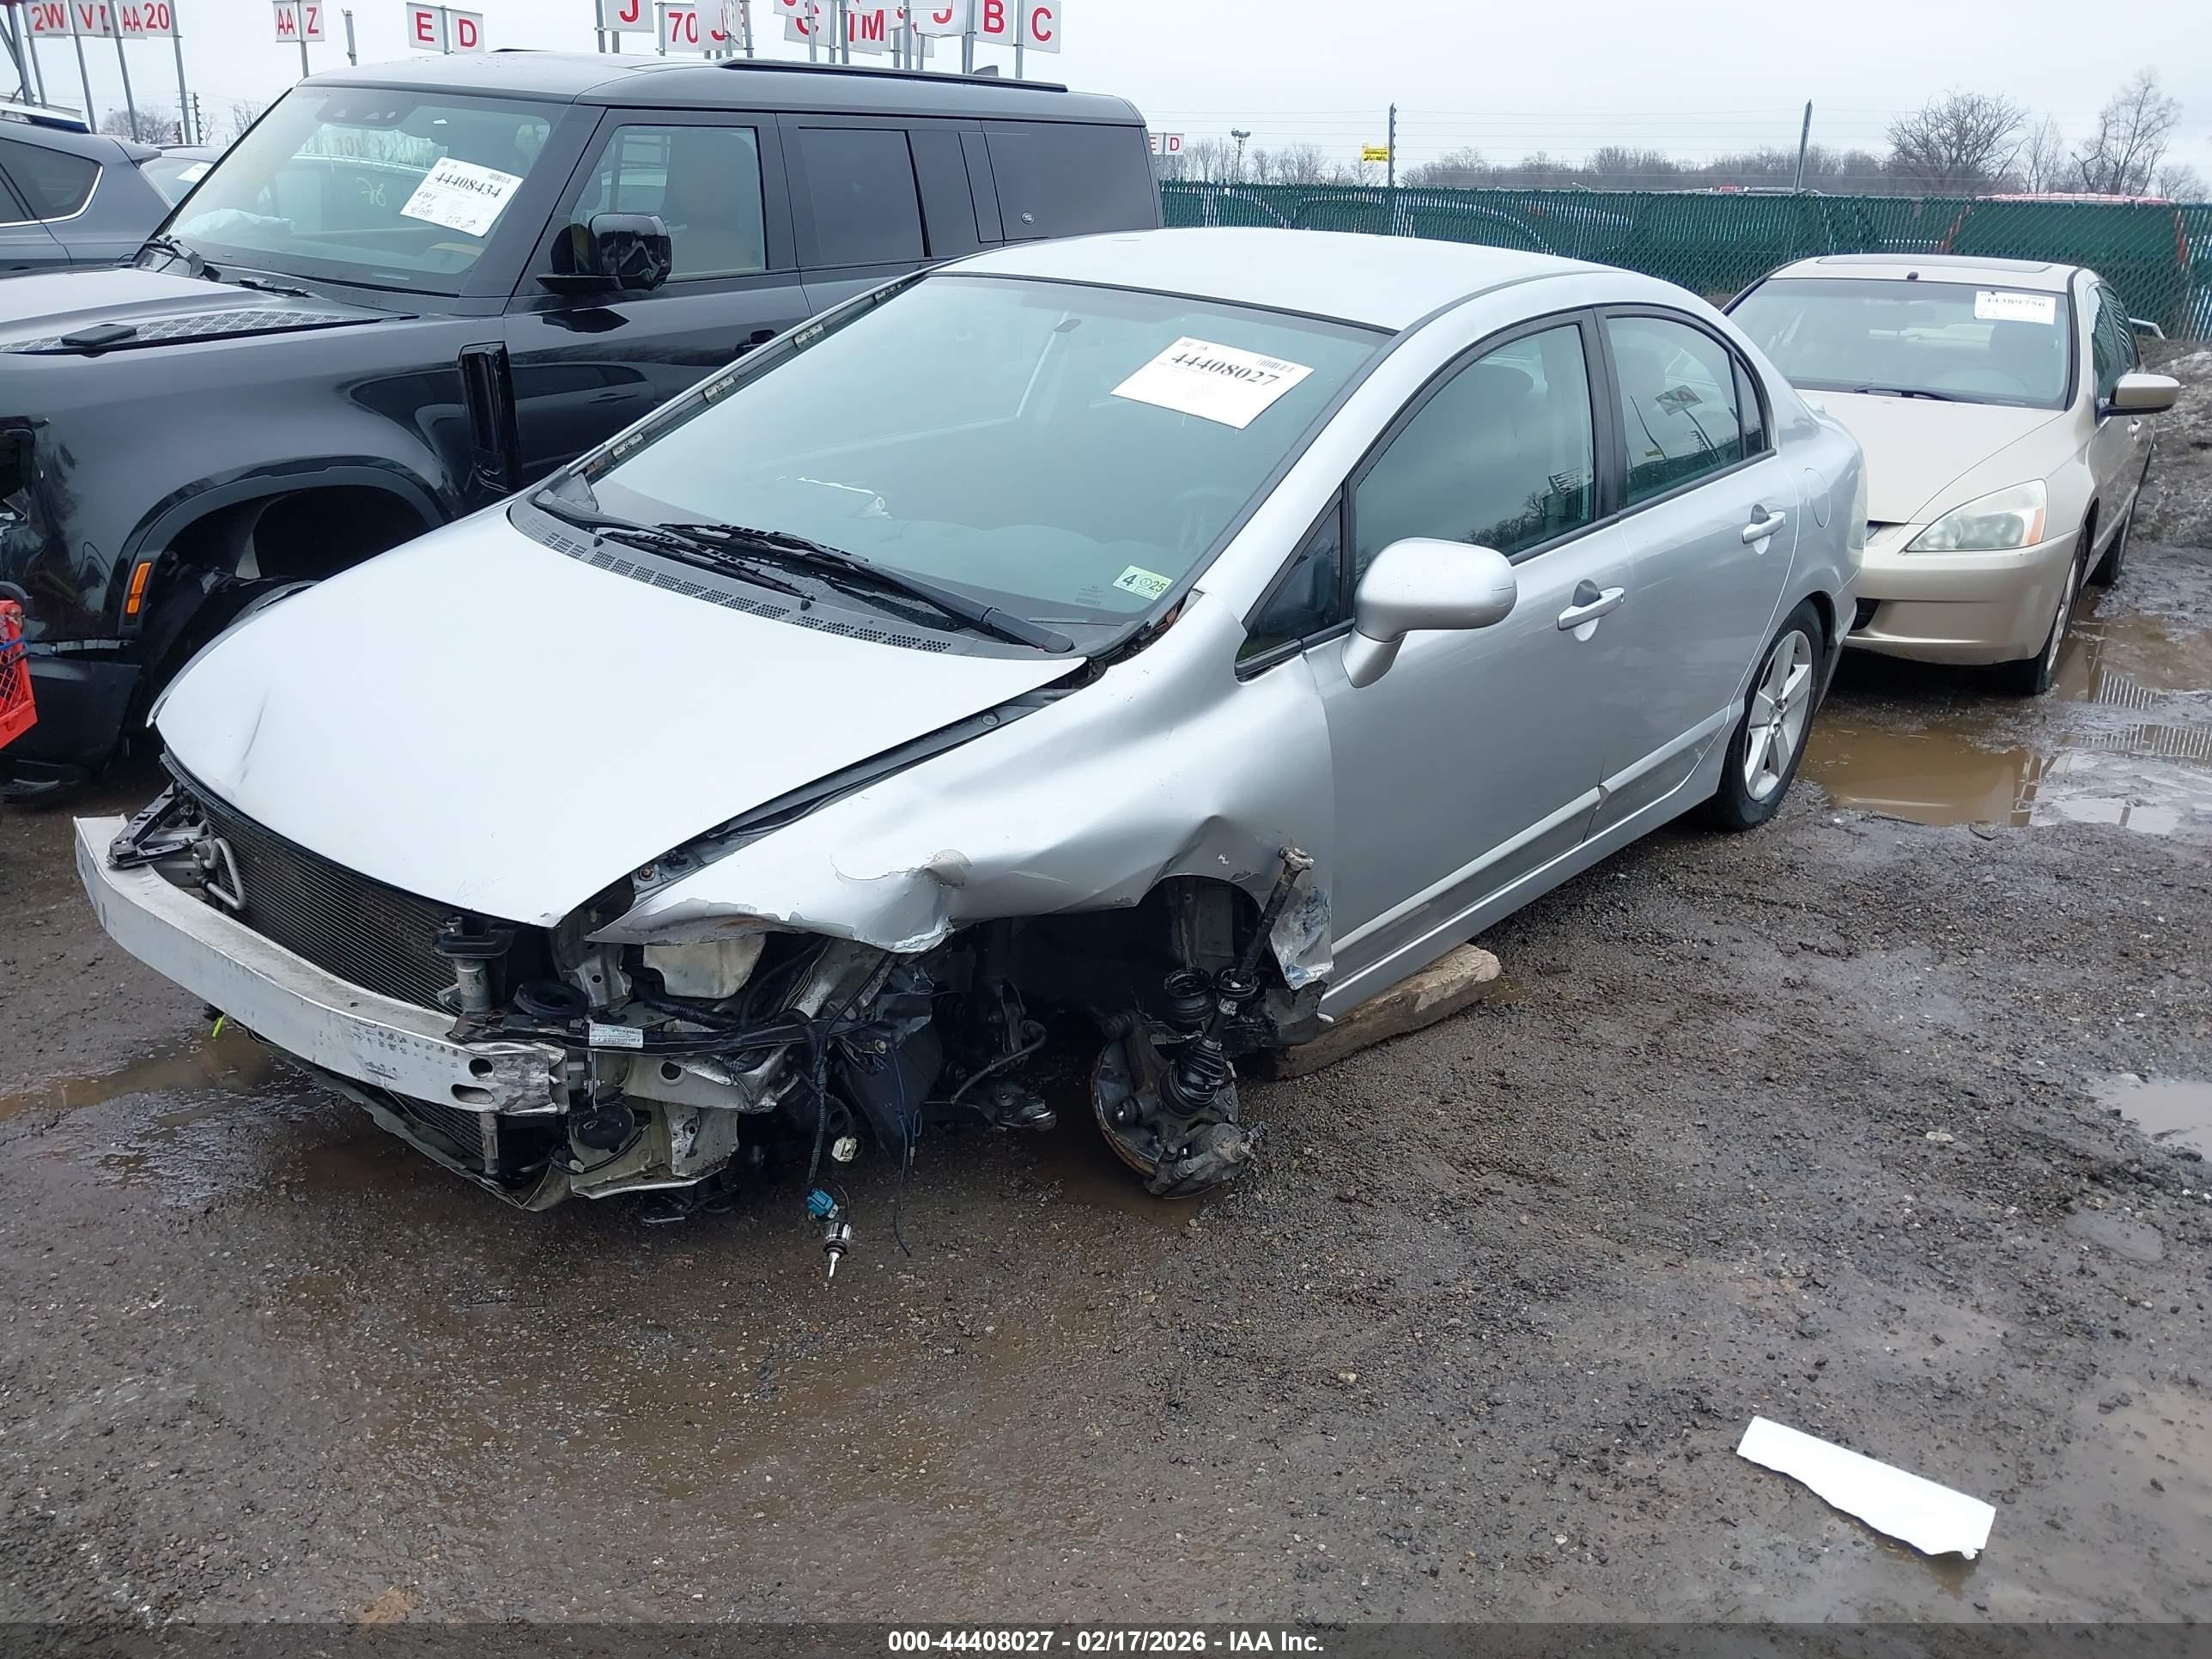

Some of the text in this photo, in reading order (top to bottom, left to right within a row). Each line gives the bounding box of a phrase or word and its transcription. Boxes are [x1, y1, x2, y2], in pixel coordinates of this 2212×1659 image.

[277, 8, 296, 35] AA
[306, 7, 319, 34] Z
[416, 12, 435, 42] E
[668, 12, 699, 44] 70
[983, 0, 1005, 33] B
[1031, 7, 1053, 42] C
[458, 19, 477, 47] D
[1170, 137, 1180, 151] D
[434, 172, 503, 198] 44408434
[1170, 353, 1281, 386] 44408027
[1122, 574, 1138, 586] 4
[1149, 580, 1167, 592] 25
